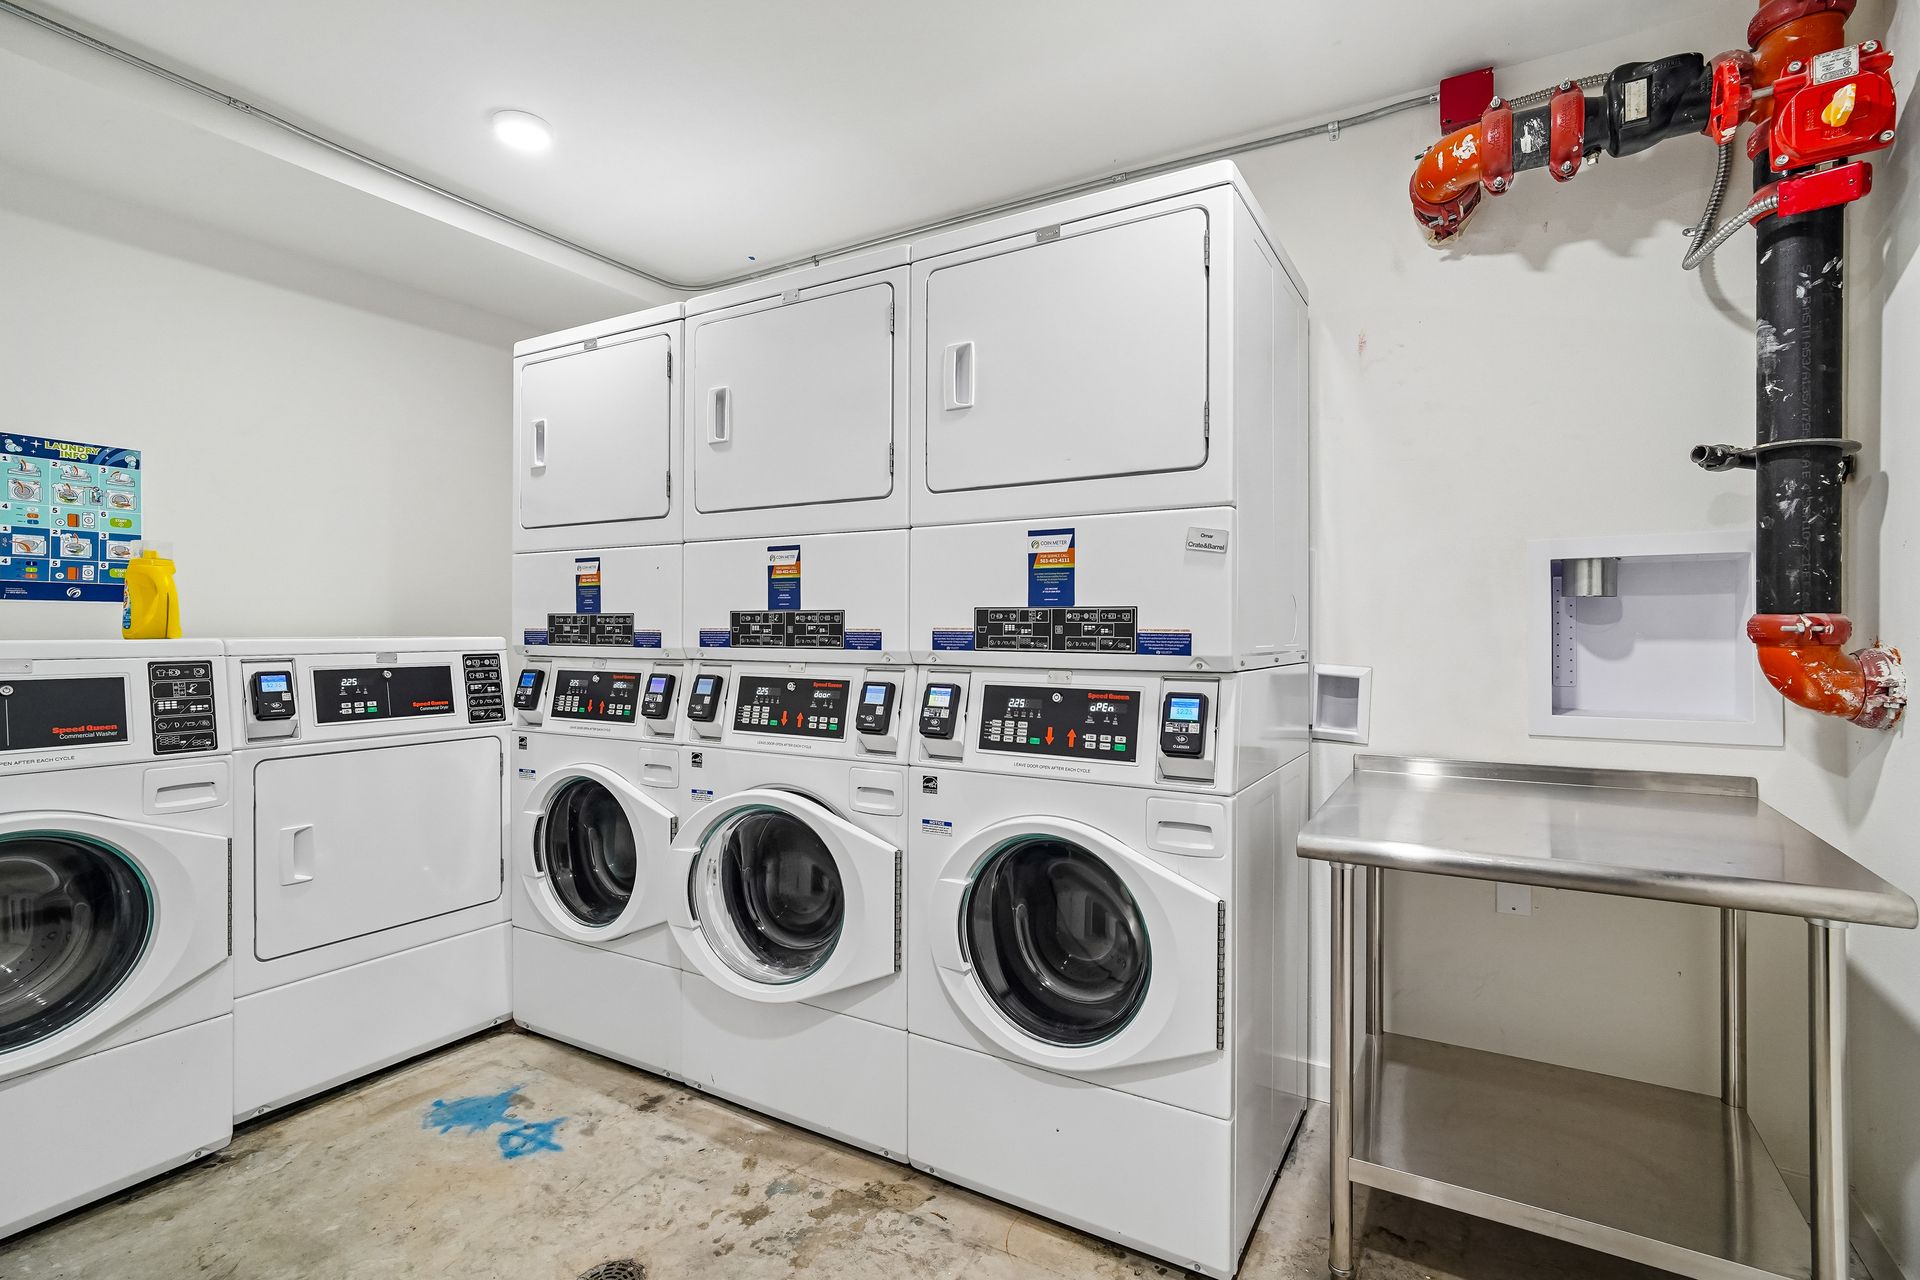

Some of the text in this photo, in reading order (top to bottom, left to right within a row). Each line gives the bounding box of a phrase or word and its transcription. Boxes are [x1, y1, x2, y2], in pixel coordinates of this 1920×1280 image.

[44, 440, 102, 456] LAUNDRY
[60, 450, 89, 460] INFO
[1188, 541, 1224, 550] Crate&Barrel
[814, 690, 831, 698] door
[52, 725, 85, 734] Speed
[60, 732, 96, 740] Commercial
